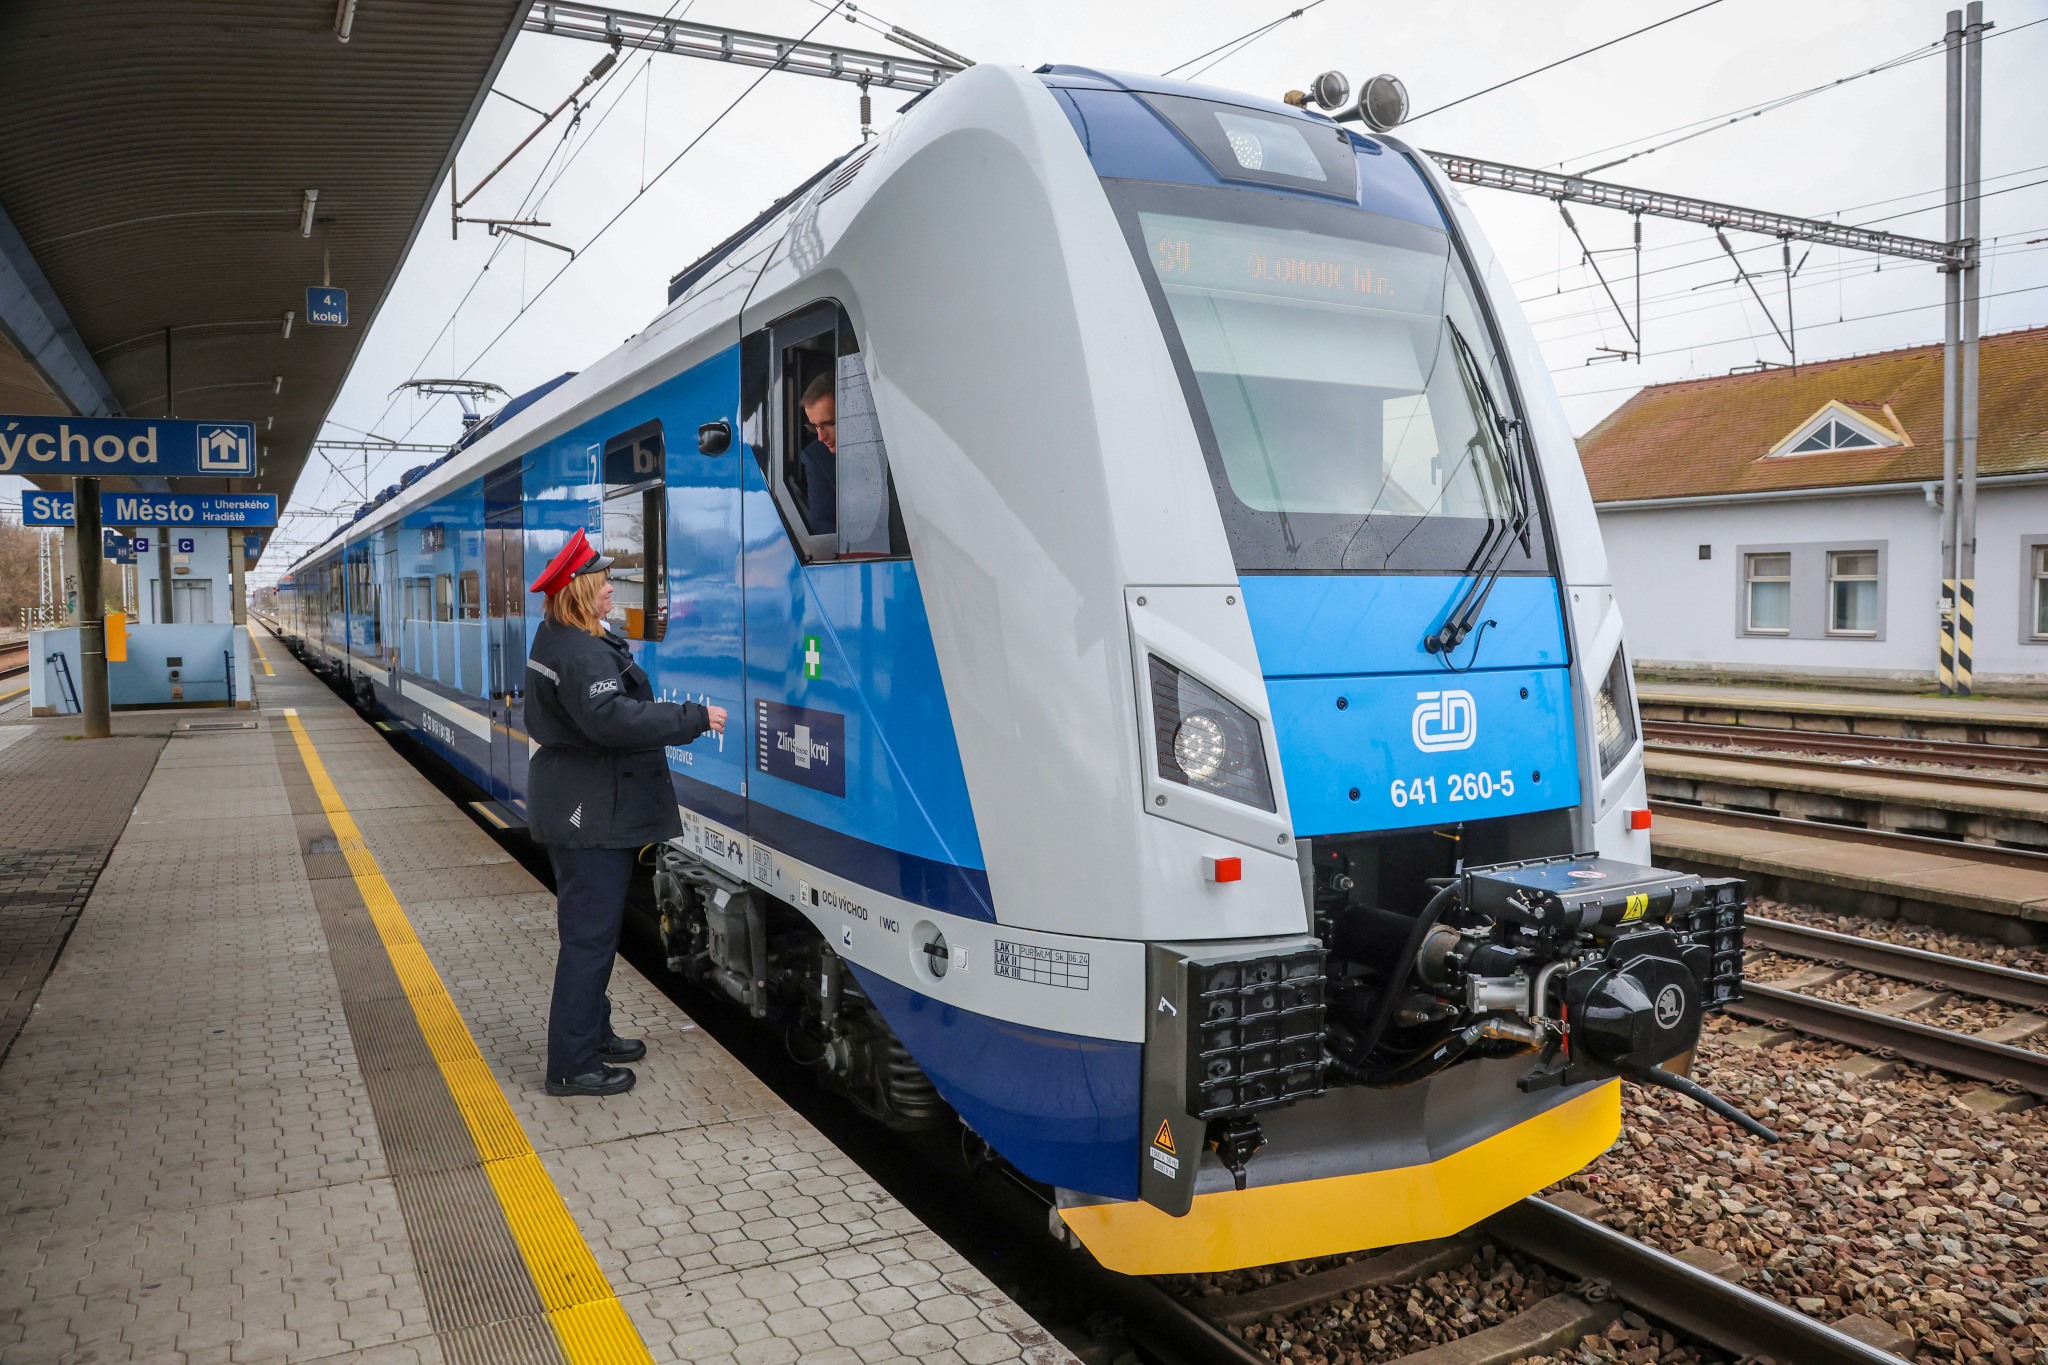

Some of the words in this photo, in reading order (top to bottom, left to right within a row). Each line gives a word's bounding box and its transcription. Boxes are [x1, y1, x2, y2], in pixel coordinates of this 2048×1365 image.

[1246, 252, 1345, 290] OLOMOUC
[323, 294, 337, 306] 4.
[312, 310, 342, 325] kolej
[0, 422, 158, 471] ýchod
[32, 496, 103, 520] Sta
[116, 498, 194, 521] Město
[202, 502, 209, 510] u
[214, 499, 270, 510] Uherského
[202, 511, 245, 522] Hradiště
[136, 540, 146, 551] C
[181, 541, 191, 552] C
[810, 738, 829, 766] kraj
[1390, 776, 1438, 808] 641
[1447, 769, 1515, 802] 260-5
[822, 890, 837, 908] OCÚ
[838, 896, 868, 920] VÝCHOD
[879, 916, 900, 934] (WC)
[996, 941, 1010, 953] LAK
[1021, 947, 1034, 957] PUR
[1035, 948, 1051, 960] WLM
[1054, 952, 1064, 961] Sk
[1068, 953, 1088, 964] 06.24
[996, 953, 1010, 965] LAK
[996, 964, 1010, 976] LAK
[1011, 967, 1020, 978] III
